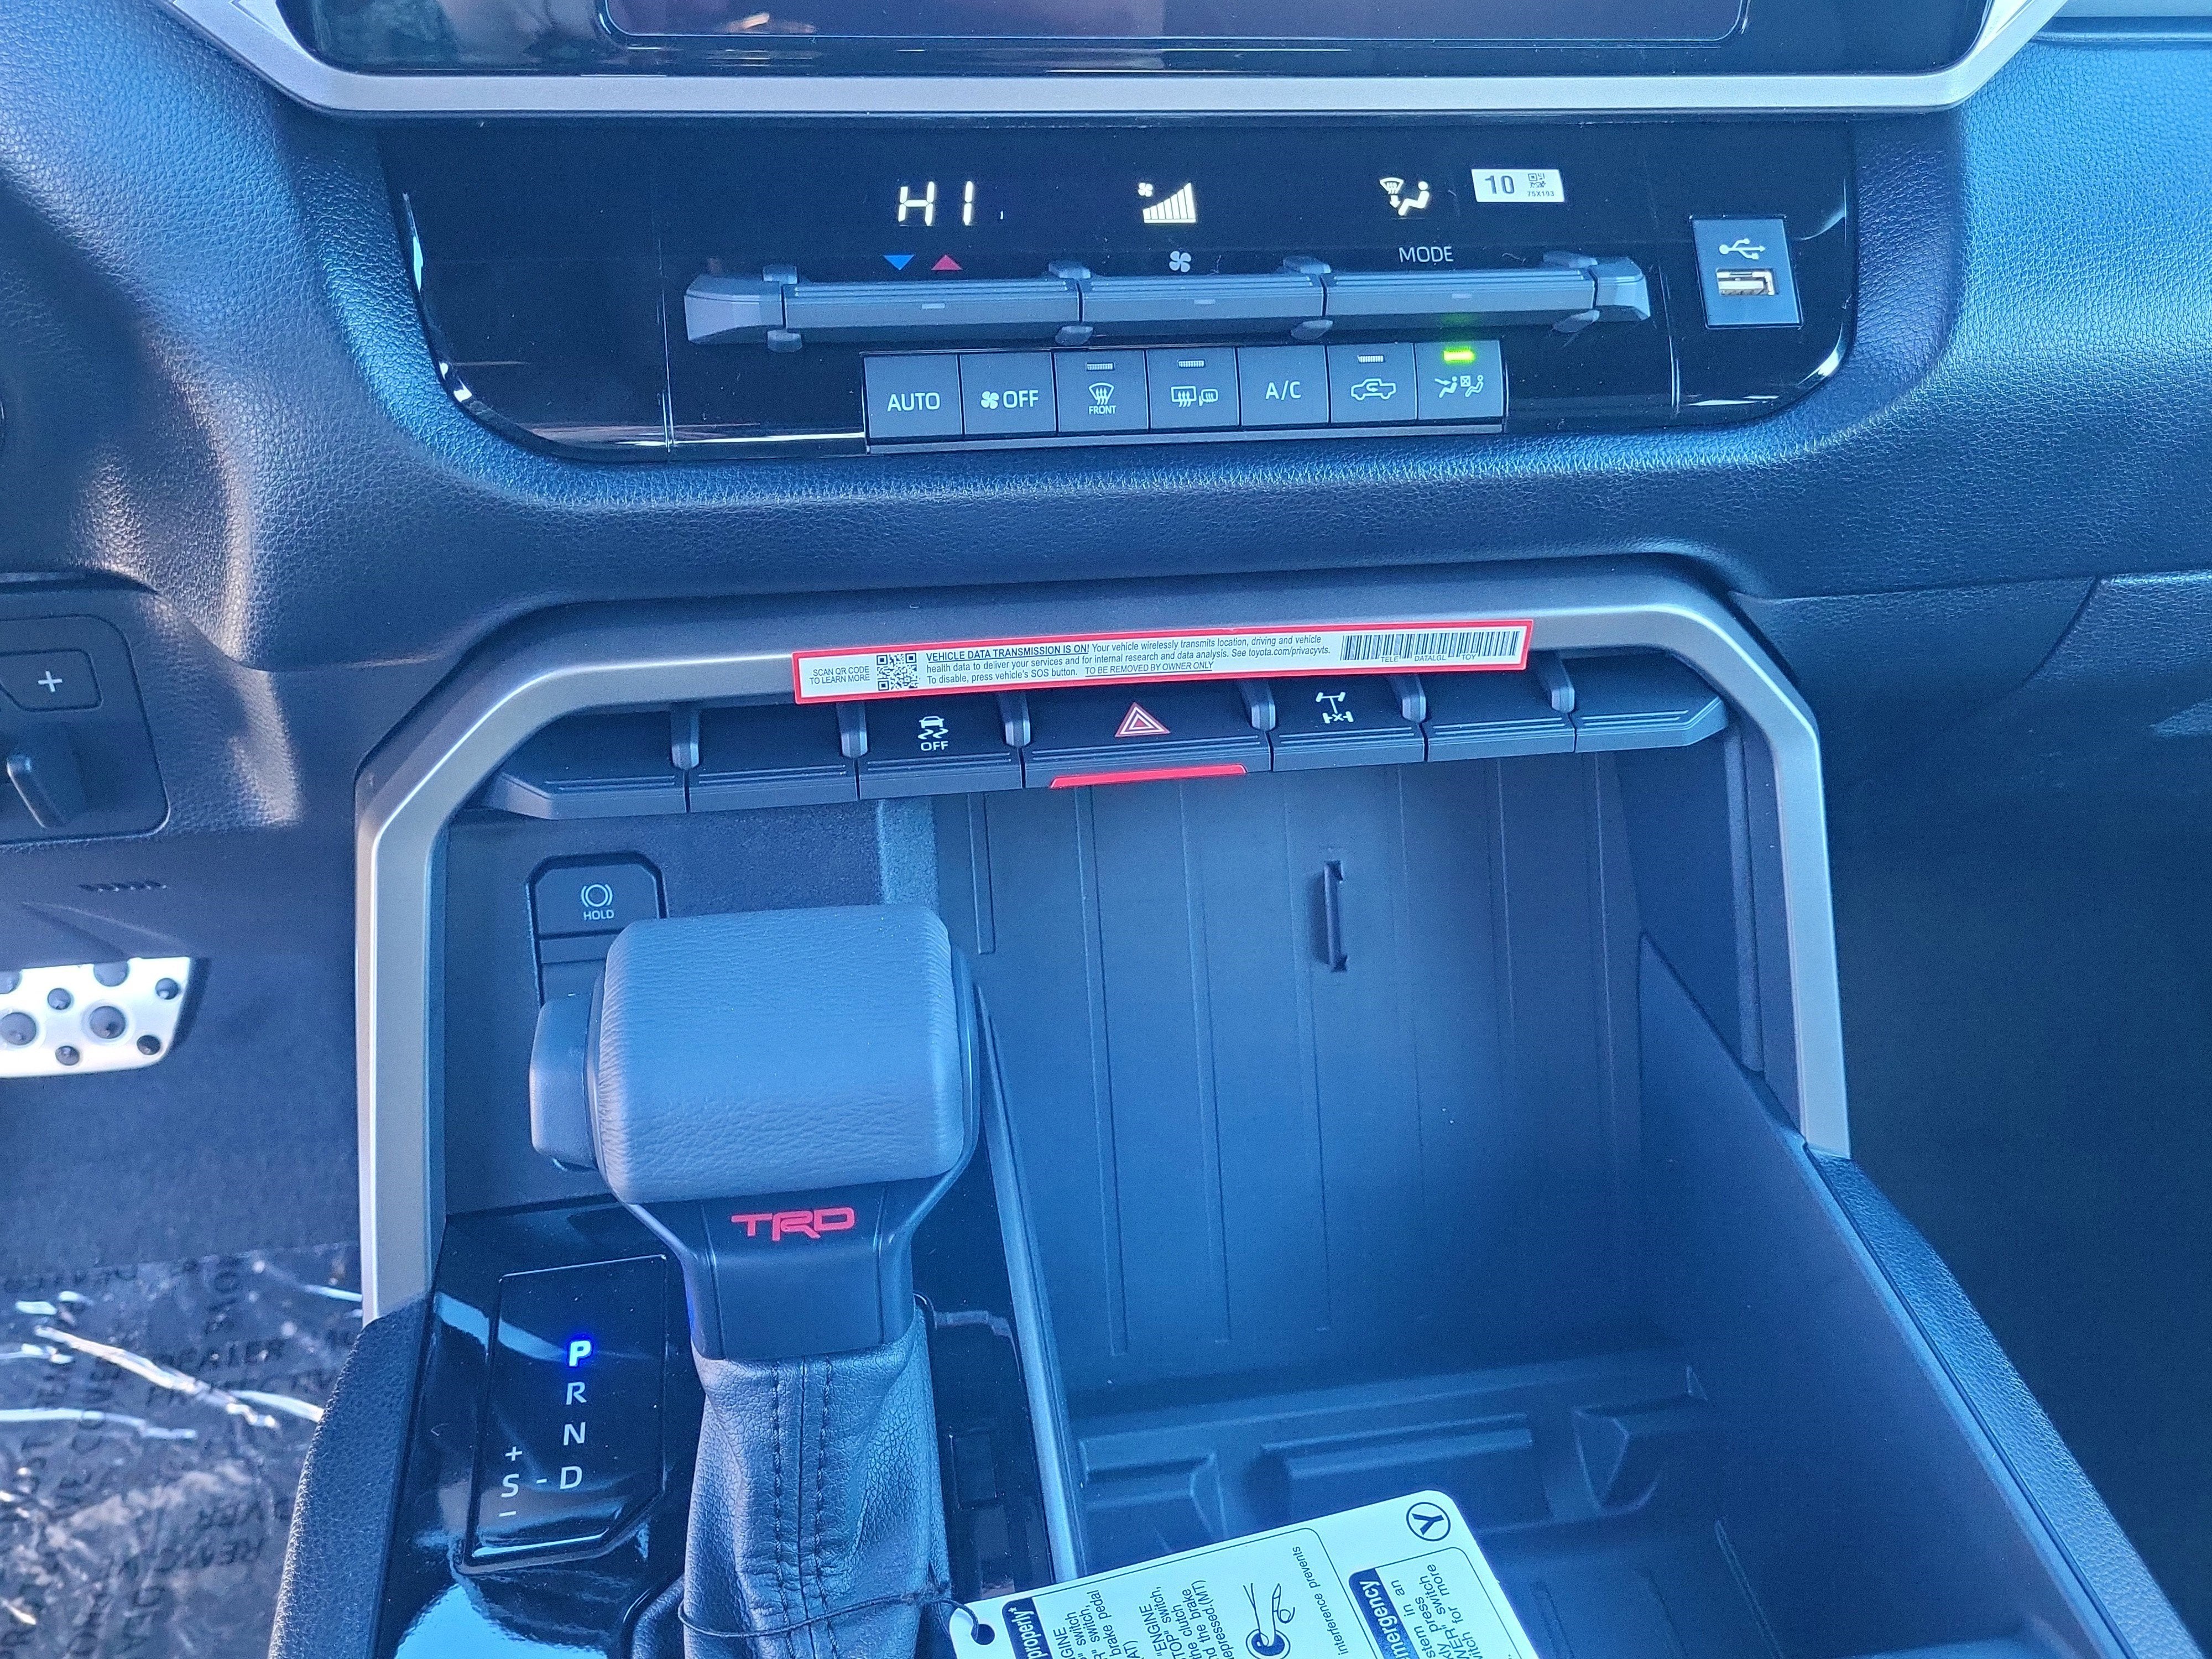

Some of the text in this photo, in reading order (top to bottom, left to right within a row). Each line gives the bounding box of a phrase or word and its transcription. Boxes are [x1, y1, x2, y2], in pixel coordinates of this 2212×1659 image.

[1485, 175, 1515, 194] 10
[898, 180, 974, 226] HI
[1399, 246, 1454, 263] MODE
[886, 392, 941, 412] AUTO
[1003, 390, 1039, 408] OFF
[1265, 380, 1301, 400] A/C
[1088, 404, 1117, 415] FRONT
[926, 634, 1321, 662] VEHICLE DATA TRANSMISSION IS ON! Your vehicle wirelessly transmits location, driving and vehicle
[848, 666, 870, 674] CODE
[927, 664, 951, 673] health
[953, 663, 971, 672] data
[983, 661, 1009, 670] deliver
[1011, 660, 1029, 670] your
[1031, 656, 1063, 667] services
[1065, 656, 1079, 665] and
[1082, 655, 1092, 664] for
[1094, 654, 1123, 664] internal
[1125, 652, 1158, 662] research
[1160, 651, 1175, 660] and
[1177, 650, 1194, 659] data
[1196, 649, 1229, 660] analysis.
[1232, 649, 1246, 658] See
[927, 661, 1214, 685] To disable, press vehicle's SOS button. TO BE REMOVED BY OWNER ONLY
[822, 675, 847, 684] LEARN
[848, 674, 870, 682] MORE
[920, 740, 949, 752] OFF
[583, 910, 615, 921] HOLD
[731, 1207, 855, 1242] TRD
[568, 1340, 592, 1367] P
[566, 1382, 587, 1405] R
[564, 1422, 587, 1445] N
[502, 1466, 582, 1498] S D
[1411, 1512, 1444, 1535] Y
[1391, 1579, 1405, 1596] an
[1427, 1564, 1449, 1597] more
[1182, 1589, 1202, 1620] brake
[1292, 1546, 1349, 1655] interference prevents
[1419, 1575, 1446, 1615] switch
[1171, 1604, 1193, 1636] clutch
[1403, 1604, 1416, 1617] in
[1415, 1597, 1442, 1633] press
[1448, 1606, 1464, 1624] for
[1065, 1611, 1086, 1646] switch
[1079, 1605, 1100, 1642] switch,
[1087, 1590, 1122, 1657] brake pedal
[1150, 1587, 1186, 1659] TOP" switch,
[1196, 1624, 1211, 1643] the
[1053, 1627, 1075, 1659] GINE
